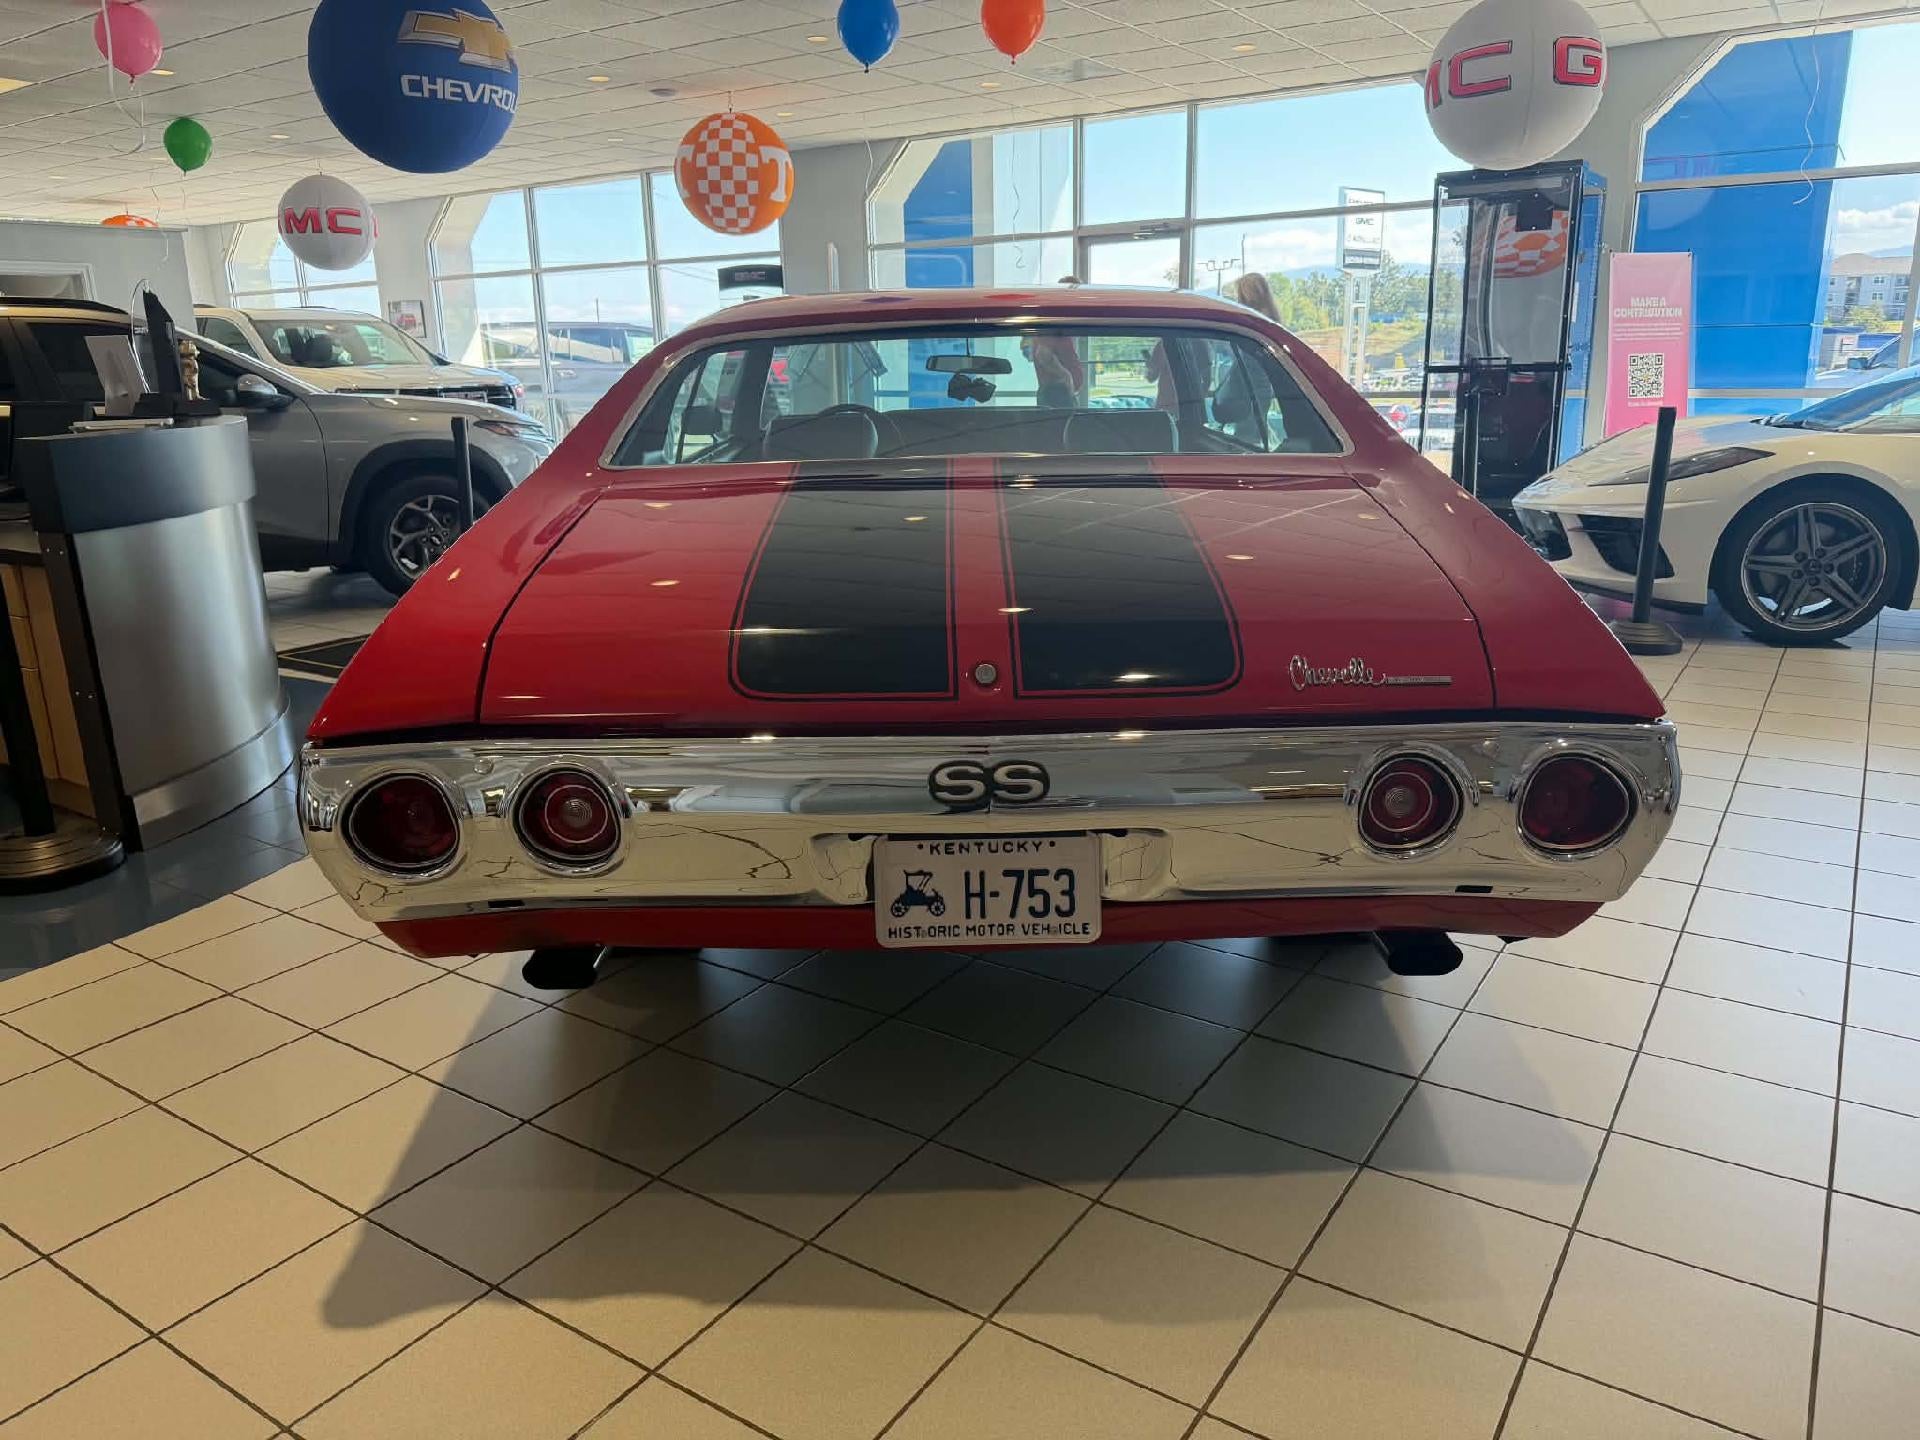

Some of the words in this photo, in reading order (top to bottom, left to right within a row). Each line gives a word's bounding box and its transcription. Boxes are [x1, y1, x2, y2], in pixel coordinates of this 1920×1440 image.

[278, 206, 363, 236] MC
[1631, 296, 1658, 308] MAKE
[1614, 307, 1682, 318] CONTRIBUTION
[931, 762, 1048, 804] SS
[929, 841, 1043, 856] KENTUCKY
[964, 868, 1076, 919] H-753
[965, 924, 1016, 937] MOTOR
[1021, 922, 1091, 936] VEHICLE
